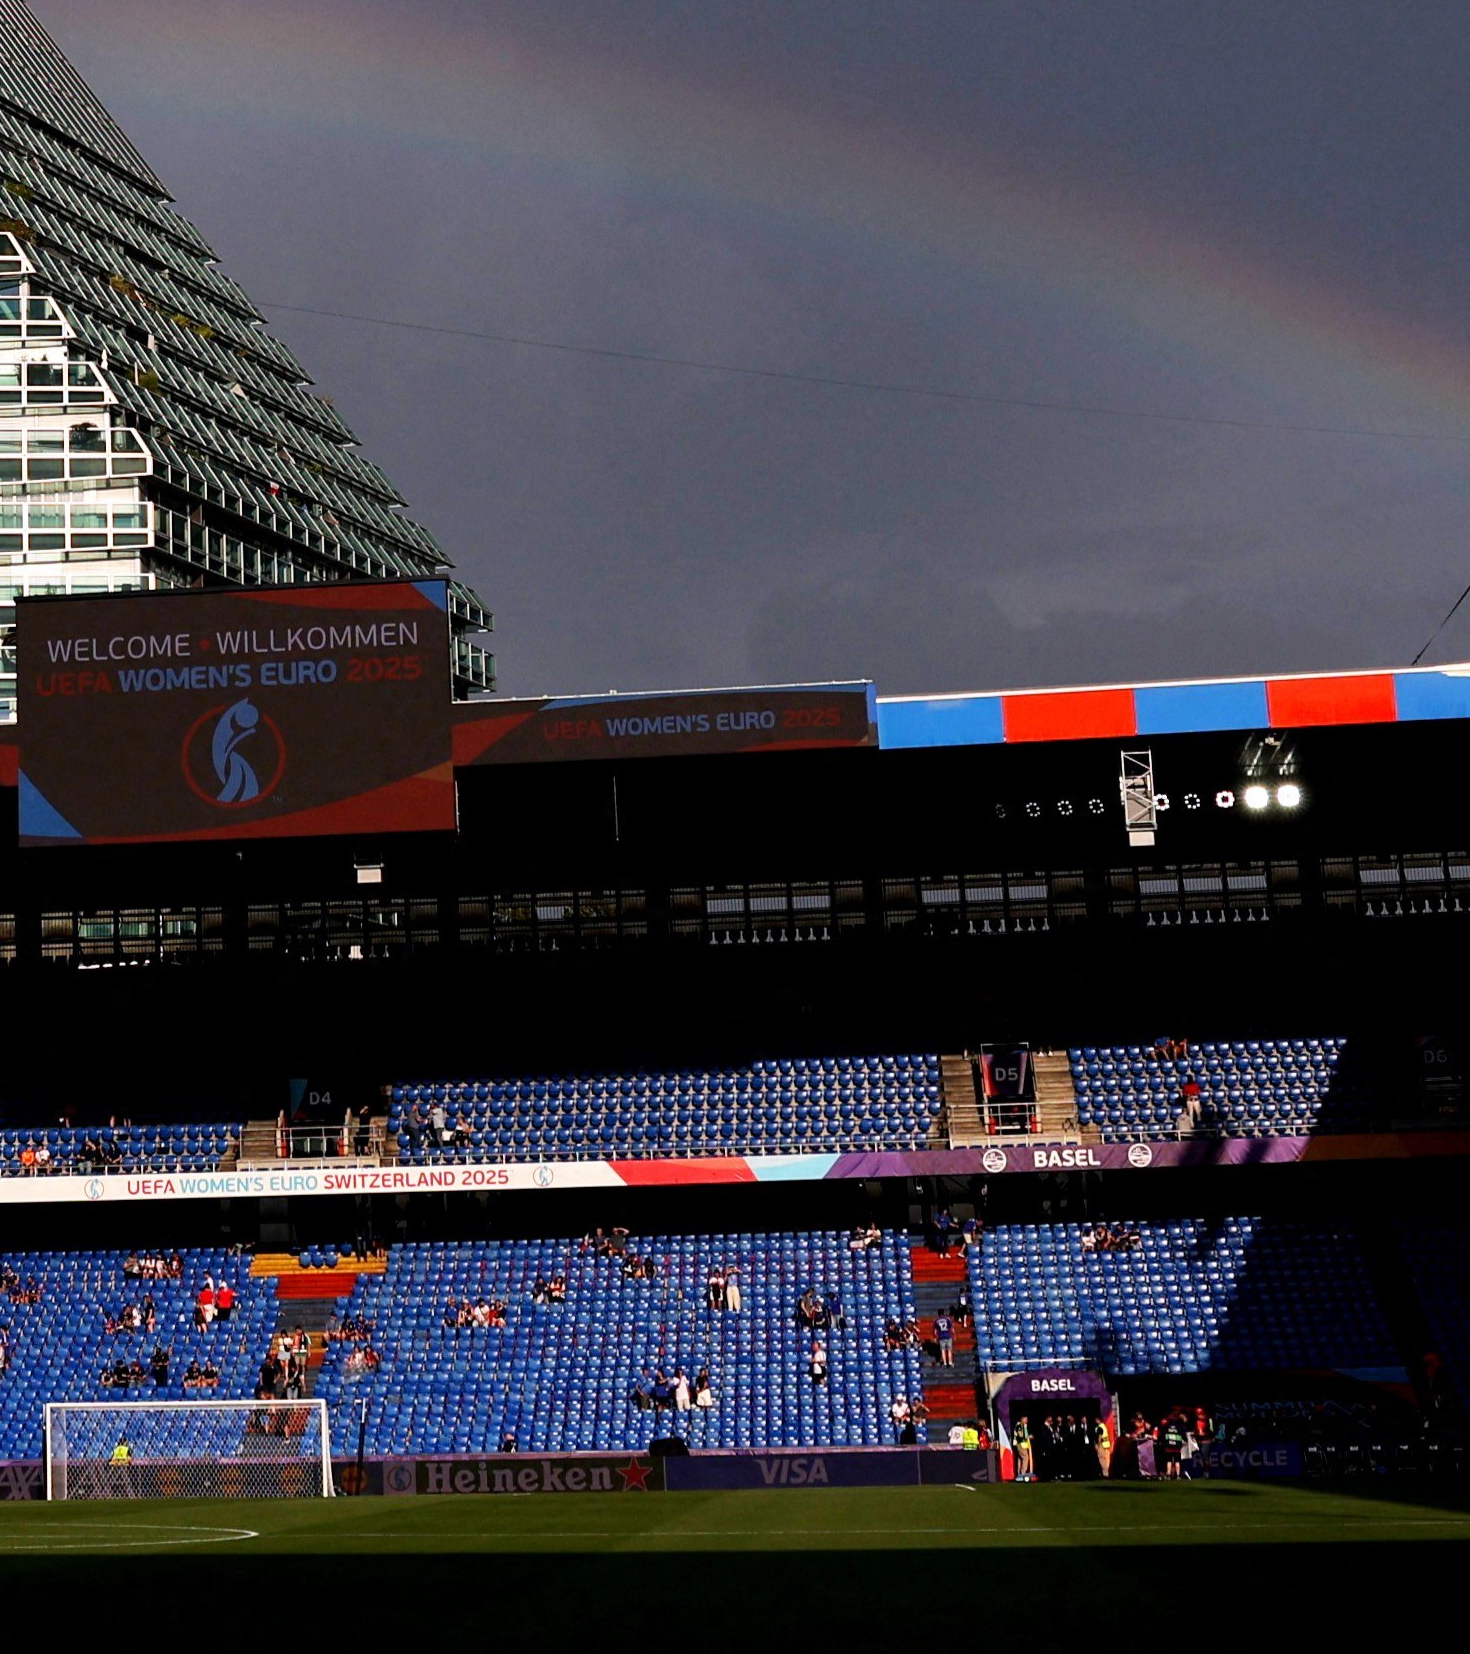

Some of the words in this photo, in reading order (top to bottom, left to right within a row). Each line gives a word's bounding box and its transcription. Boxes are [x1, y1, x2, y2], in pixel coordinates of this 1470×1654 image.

[47, 633, 191, 663] WELCOME
[216, 622, 419, 654] WILLKOMMEN
[35, 673, 113, 697] UEFA
[118, 663, 253, 693] WOMEN'S
[260, 659, 338, 686] EURO
[347, 656, 422, 683] 2025
[543, 720, 602, 740] UEFA
[606, 714, 710, 736] WOMEN'S
[716, 711, 776, 730] EURO
[783, 708, 841, 728] 2025
[994, 1068, 1019, 1082] D5
[309, 1092, 333, 1106] D4
[1033, 1148, 1101, 1168] BASEL
[127, 1179, 176, 1195] UEFA
[180, 1176, 264, 1194] WOMEN'S
[269, 1175, 318, 1192] EURO
[323, 1171, 456, 1190] SWITZERLAND
[461, 1169, 510, 1185] 2025
[1030, 1378, 1076, 1393] BASEL
[425, 1459, 616, 1495] Heineken
[755, 1456, 829, 1486] VISA
